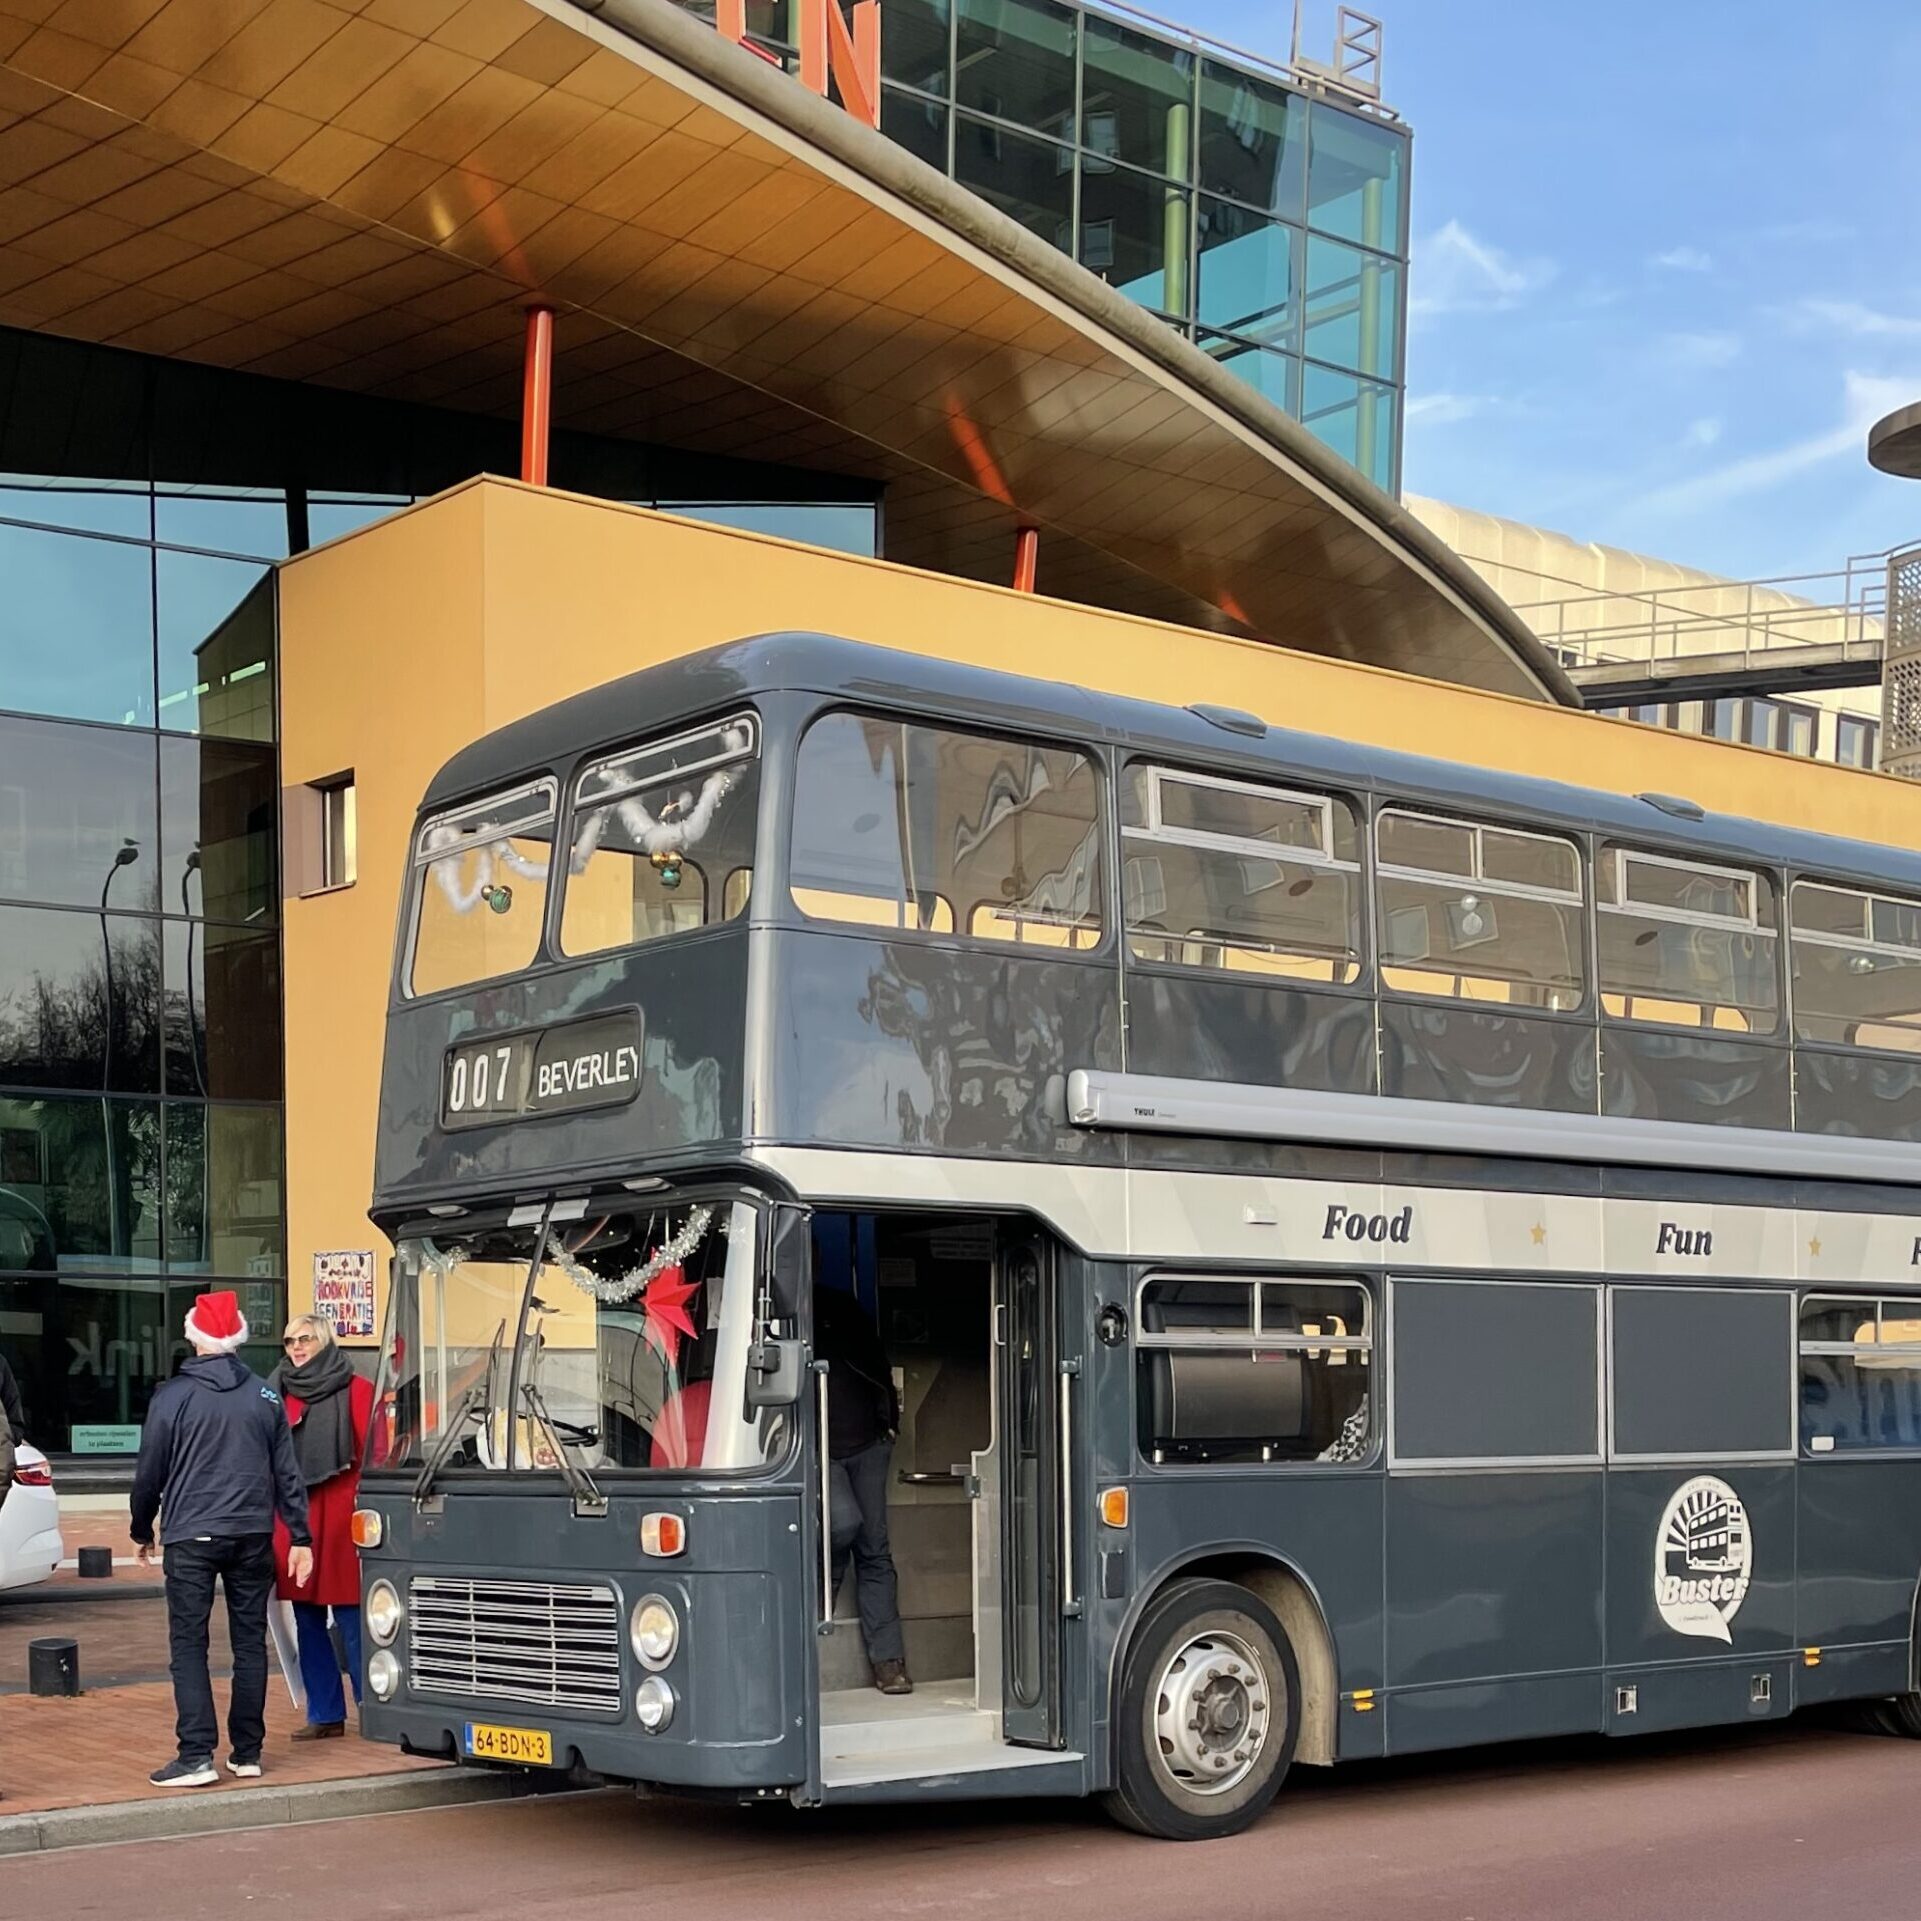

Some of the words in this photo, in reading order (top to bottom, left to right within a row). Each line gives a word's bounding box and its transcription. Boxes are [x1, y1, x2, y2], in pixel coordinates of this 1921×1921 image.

[450, 1047, 511, 1112] 007
[538, 1046, 639, 1098] BEVERLEY
[1322, 1204, 1413, 1243] Food
[1656, 1222, 1712, 1256] Fun
[1660, 1573, 1749, 1606] Buster
[476, 1730, 545, 1759] 64-BDN-3
